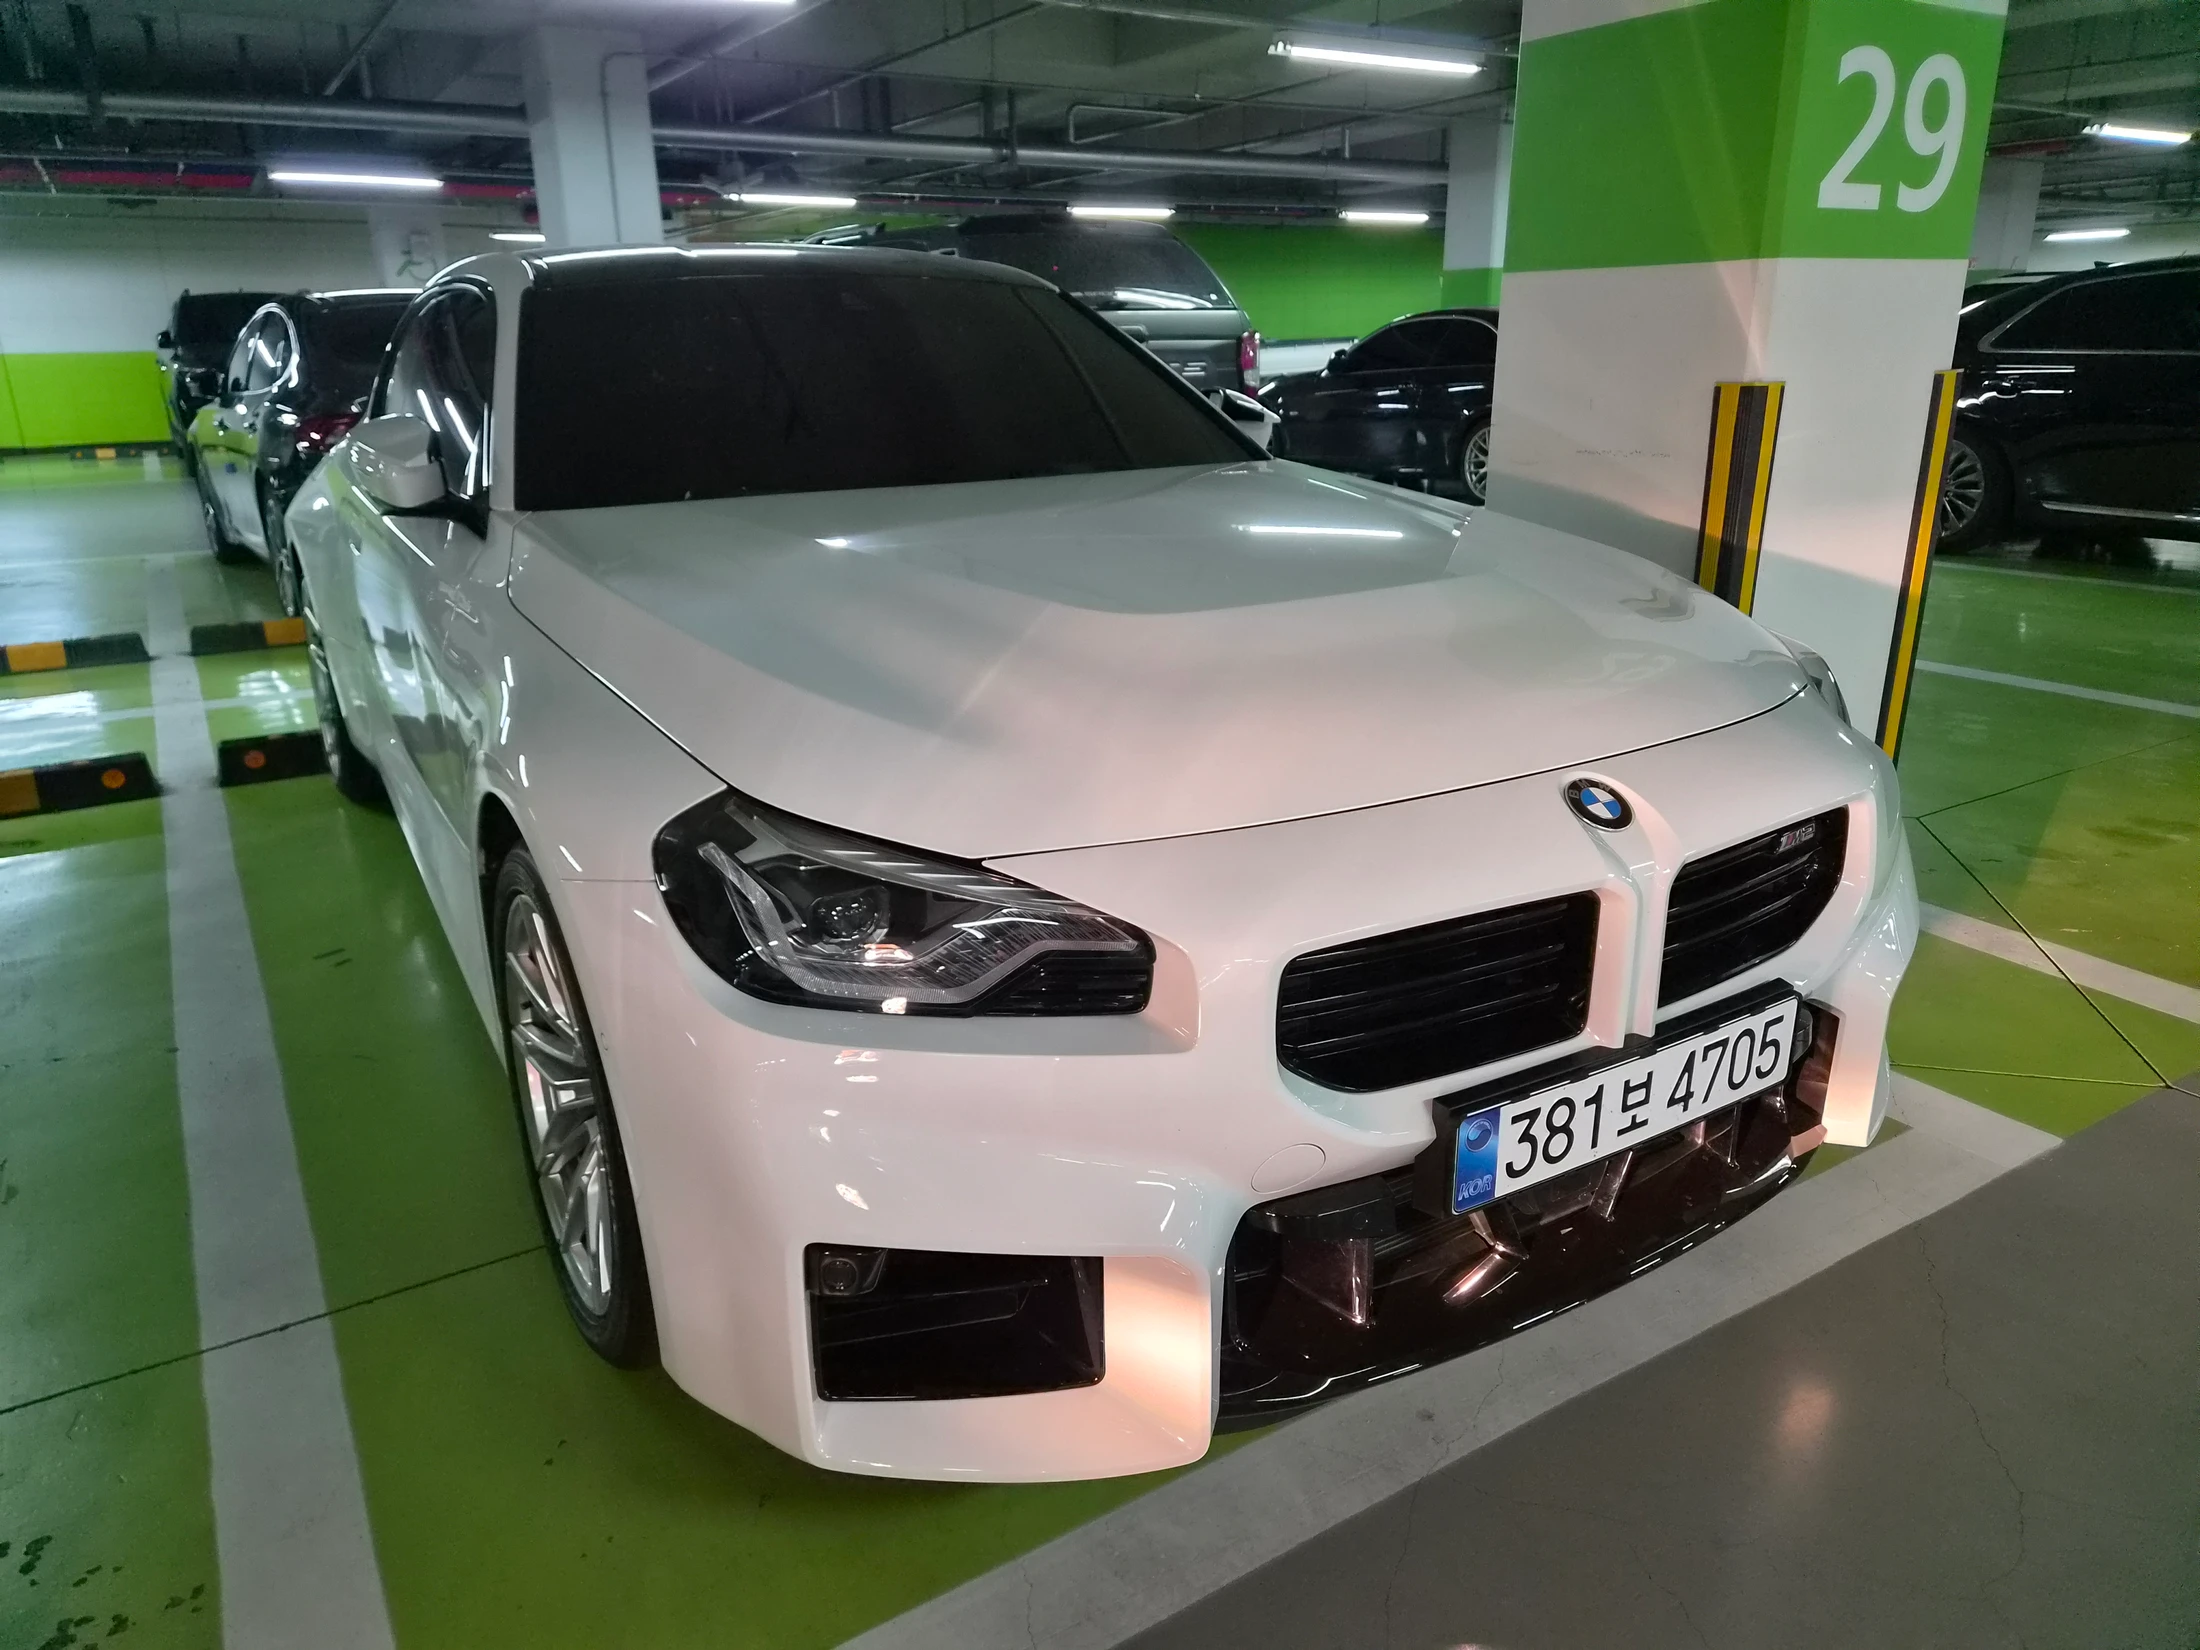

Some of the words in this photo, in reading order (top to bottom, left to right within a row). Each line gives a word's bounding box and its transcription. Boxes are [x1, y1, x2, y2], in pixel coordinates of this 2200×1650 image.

[1817, 45, 1966, 212] 29
[1568, 779, 1612, 799] BMW
[1505, 1070, 1654, 1179] 381보
[1667, 1015, 1785, 1113] 4705
[1458, 1174, 1492, 1201] KOR
